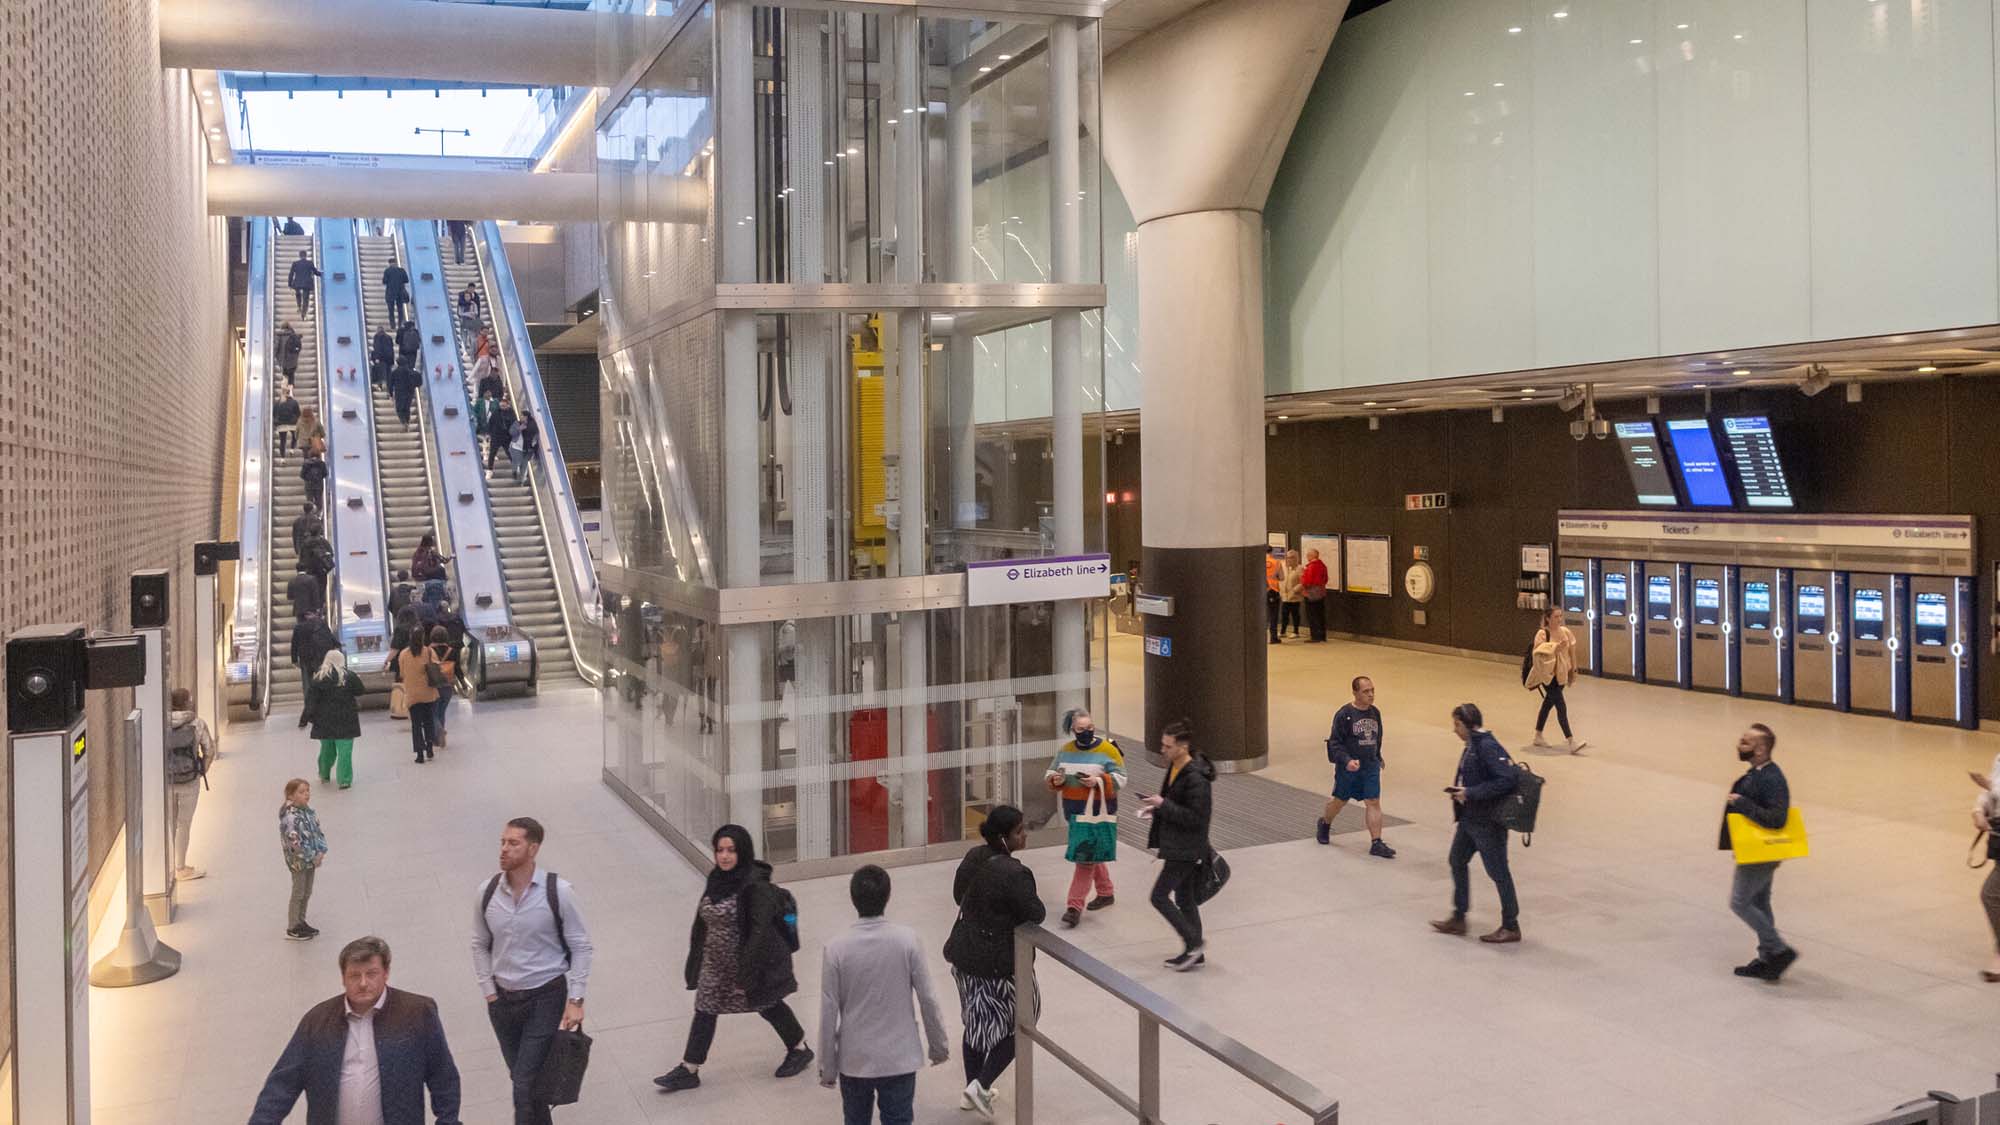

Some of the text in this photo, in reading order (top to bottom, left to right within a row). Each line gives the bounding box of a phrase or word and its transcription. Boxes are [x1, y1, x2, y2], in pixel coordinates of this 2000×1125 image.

[1662, 525, 1690, 535] Tickets
[1023, 565, 1096, 579] Elizabeth line
